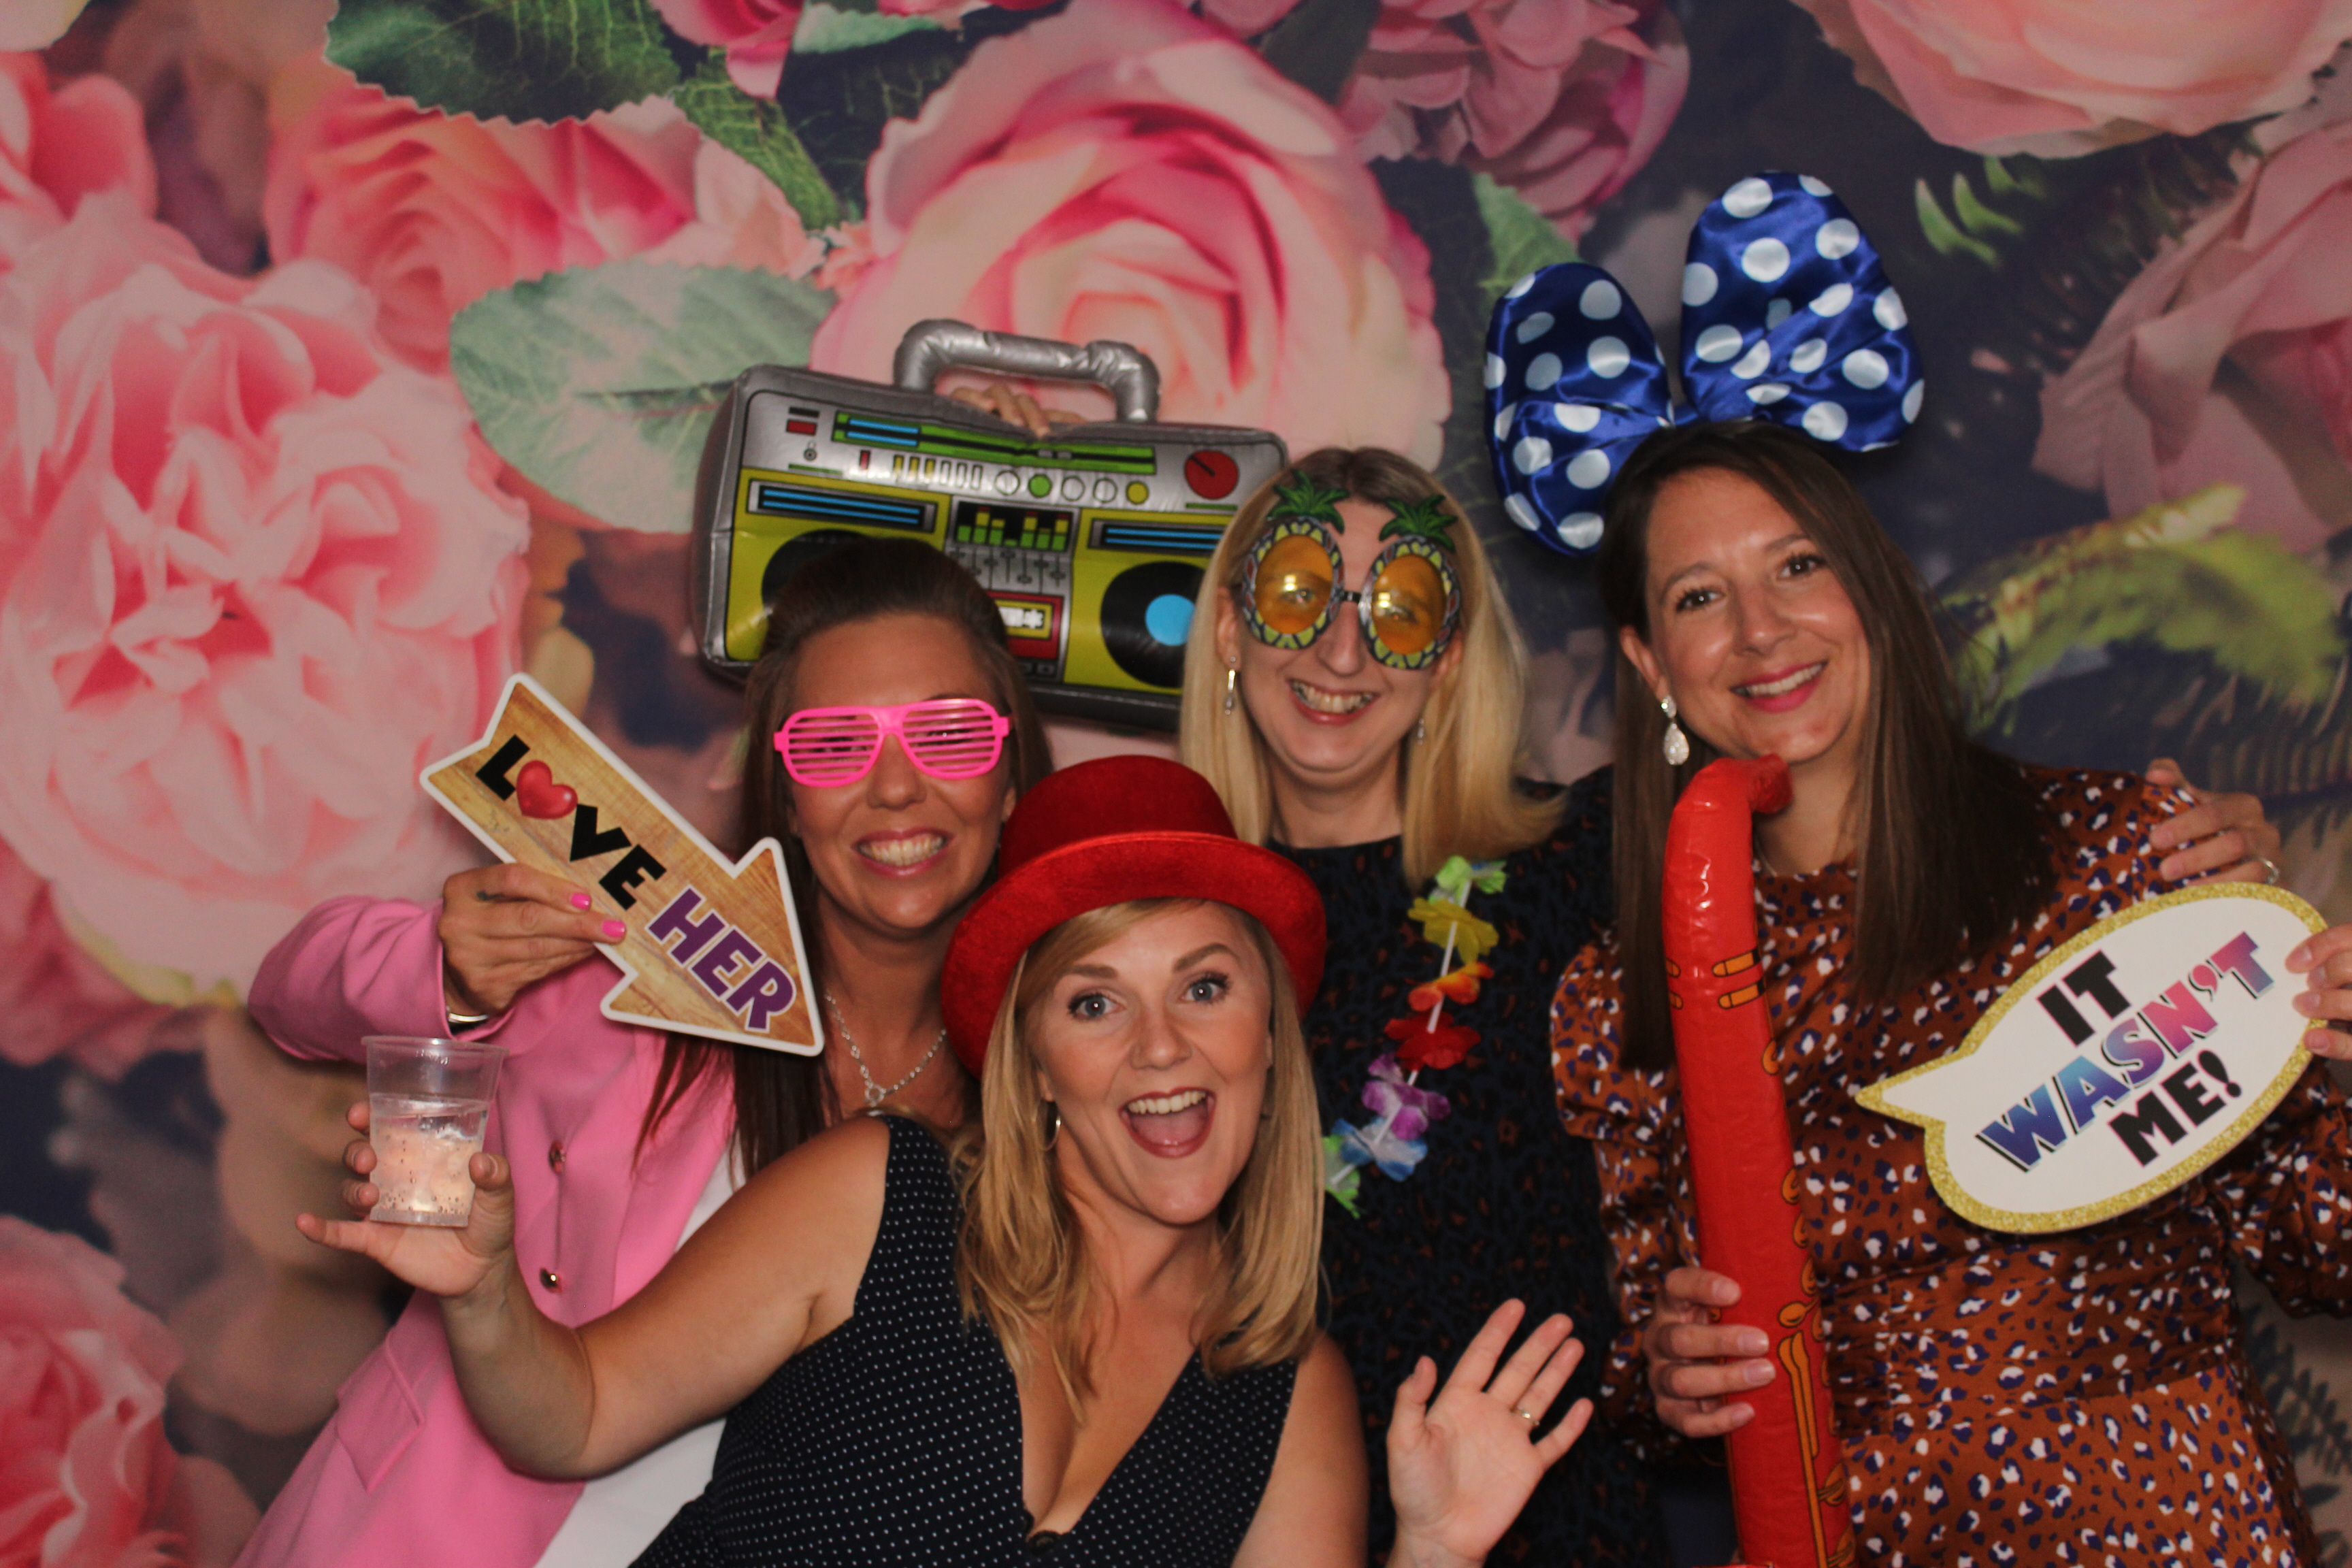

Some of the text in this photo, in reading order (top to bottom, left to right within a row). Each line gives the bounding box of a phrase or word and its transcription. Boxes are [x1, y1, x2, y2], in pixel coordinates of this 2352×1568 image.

[644, 883, 797, 1034] HER
[2036, 949, 2133, 1049] IT
[1975, 931, 2274, 1173] WASN'T
[2106, 1049, 2242, 1168] ME!
